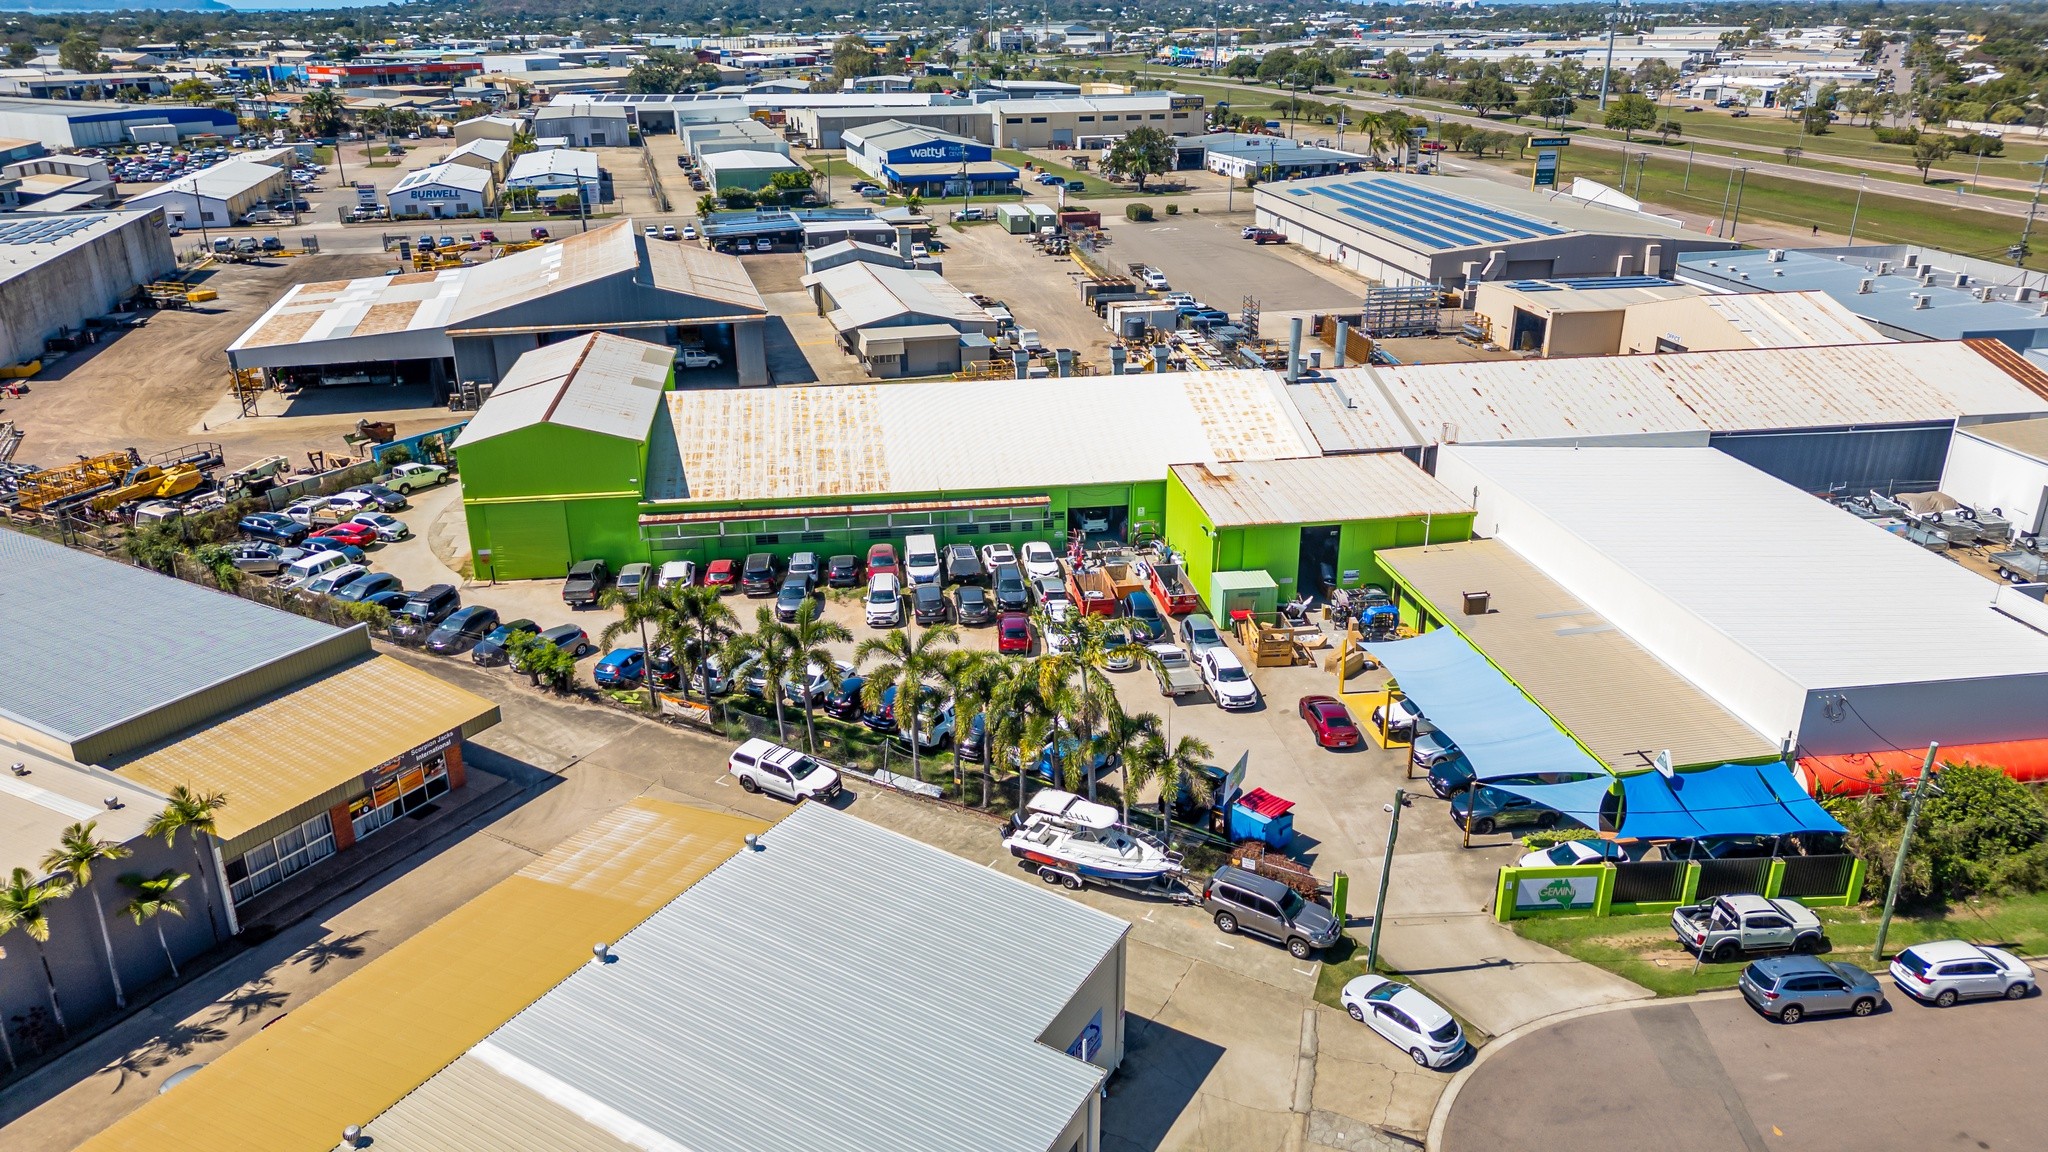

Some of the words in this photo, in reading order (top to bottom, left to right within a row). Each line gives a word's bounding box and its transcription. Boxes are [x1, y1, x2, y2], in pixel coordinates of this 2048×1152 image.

[411, 189, 461, 199] BURWELL
[410, 740, 437, 756] Scorpion
[437, 731, 454, 743] Jacks
[416, 740, 452, 761] International
[1539, 887, 1575, 897] GEMINI
